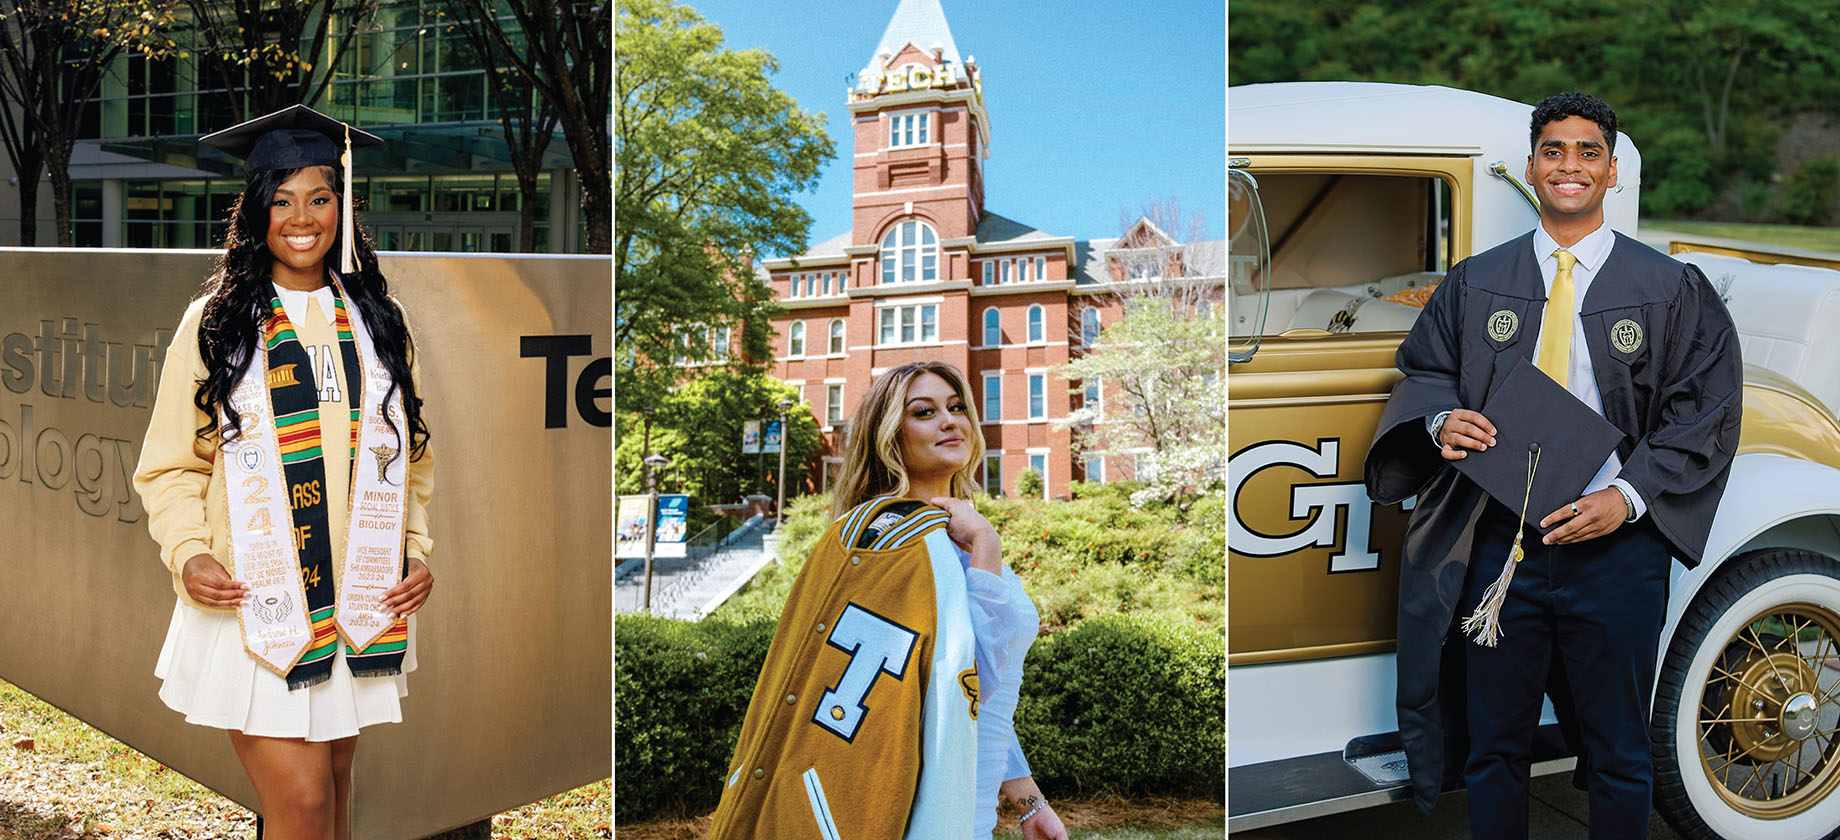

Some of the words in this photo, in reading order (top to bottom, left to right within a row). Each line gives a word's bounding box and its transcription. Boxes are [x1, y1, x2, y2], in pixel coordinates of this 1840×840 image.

[858, 63, 957, 96] TECH
[520, 334, 612, 429] Te
[291, 480, 321, 510] ASS
[363, 490, 398, 503] MINOR
[360, 501, 377, 511] SOCIAL
[378, 503, 399, 513] JUSTICE
[1228, 437, 1384, 575] GT
[358, 520, 396, 531] BIOLOGY
[357, 572, 385, 581] 2023-24
[348, 619, 380, 628] 2023-24
[811, 601, 920, 744] T
